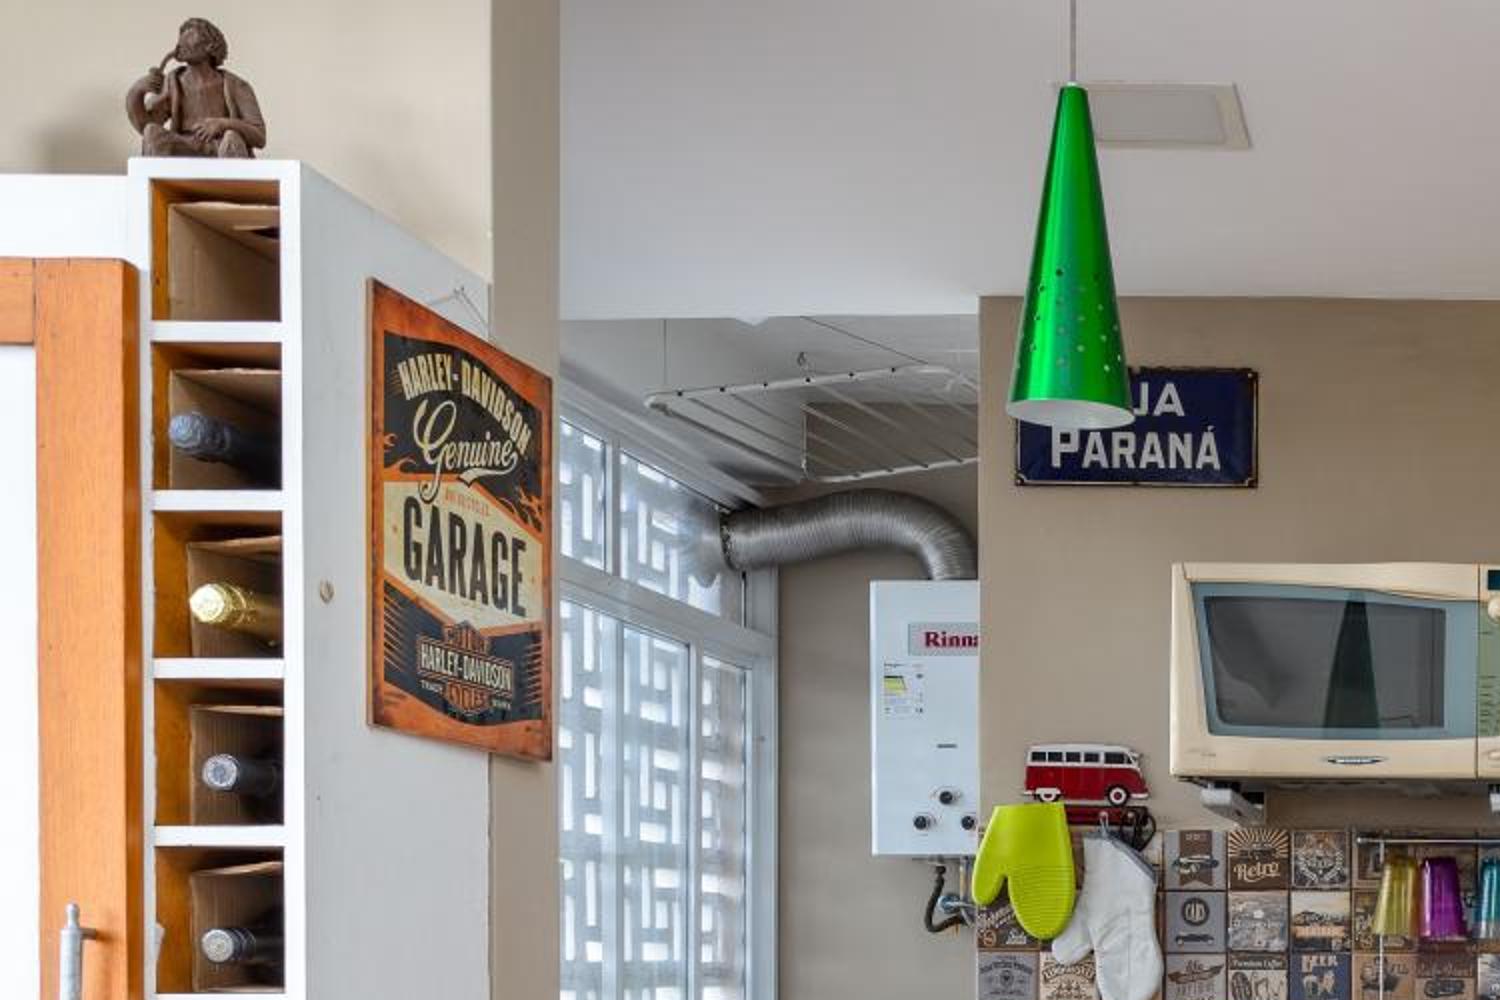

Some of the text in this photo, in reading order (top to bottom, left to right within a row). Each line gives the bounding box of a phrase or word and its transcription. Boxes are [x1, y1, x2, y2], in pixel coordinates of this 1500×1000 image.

[397, 353, 532, 455] HARLEY-DAVIDSON
[413, 399, 518, 500] Genuine
[1051, 424, 1220, 471] PARANÁ
[403, 496, 527, 618] GARAGE
[1233, 861, 1281, 883] Retro
